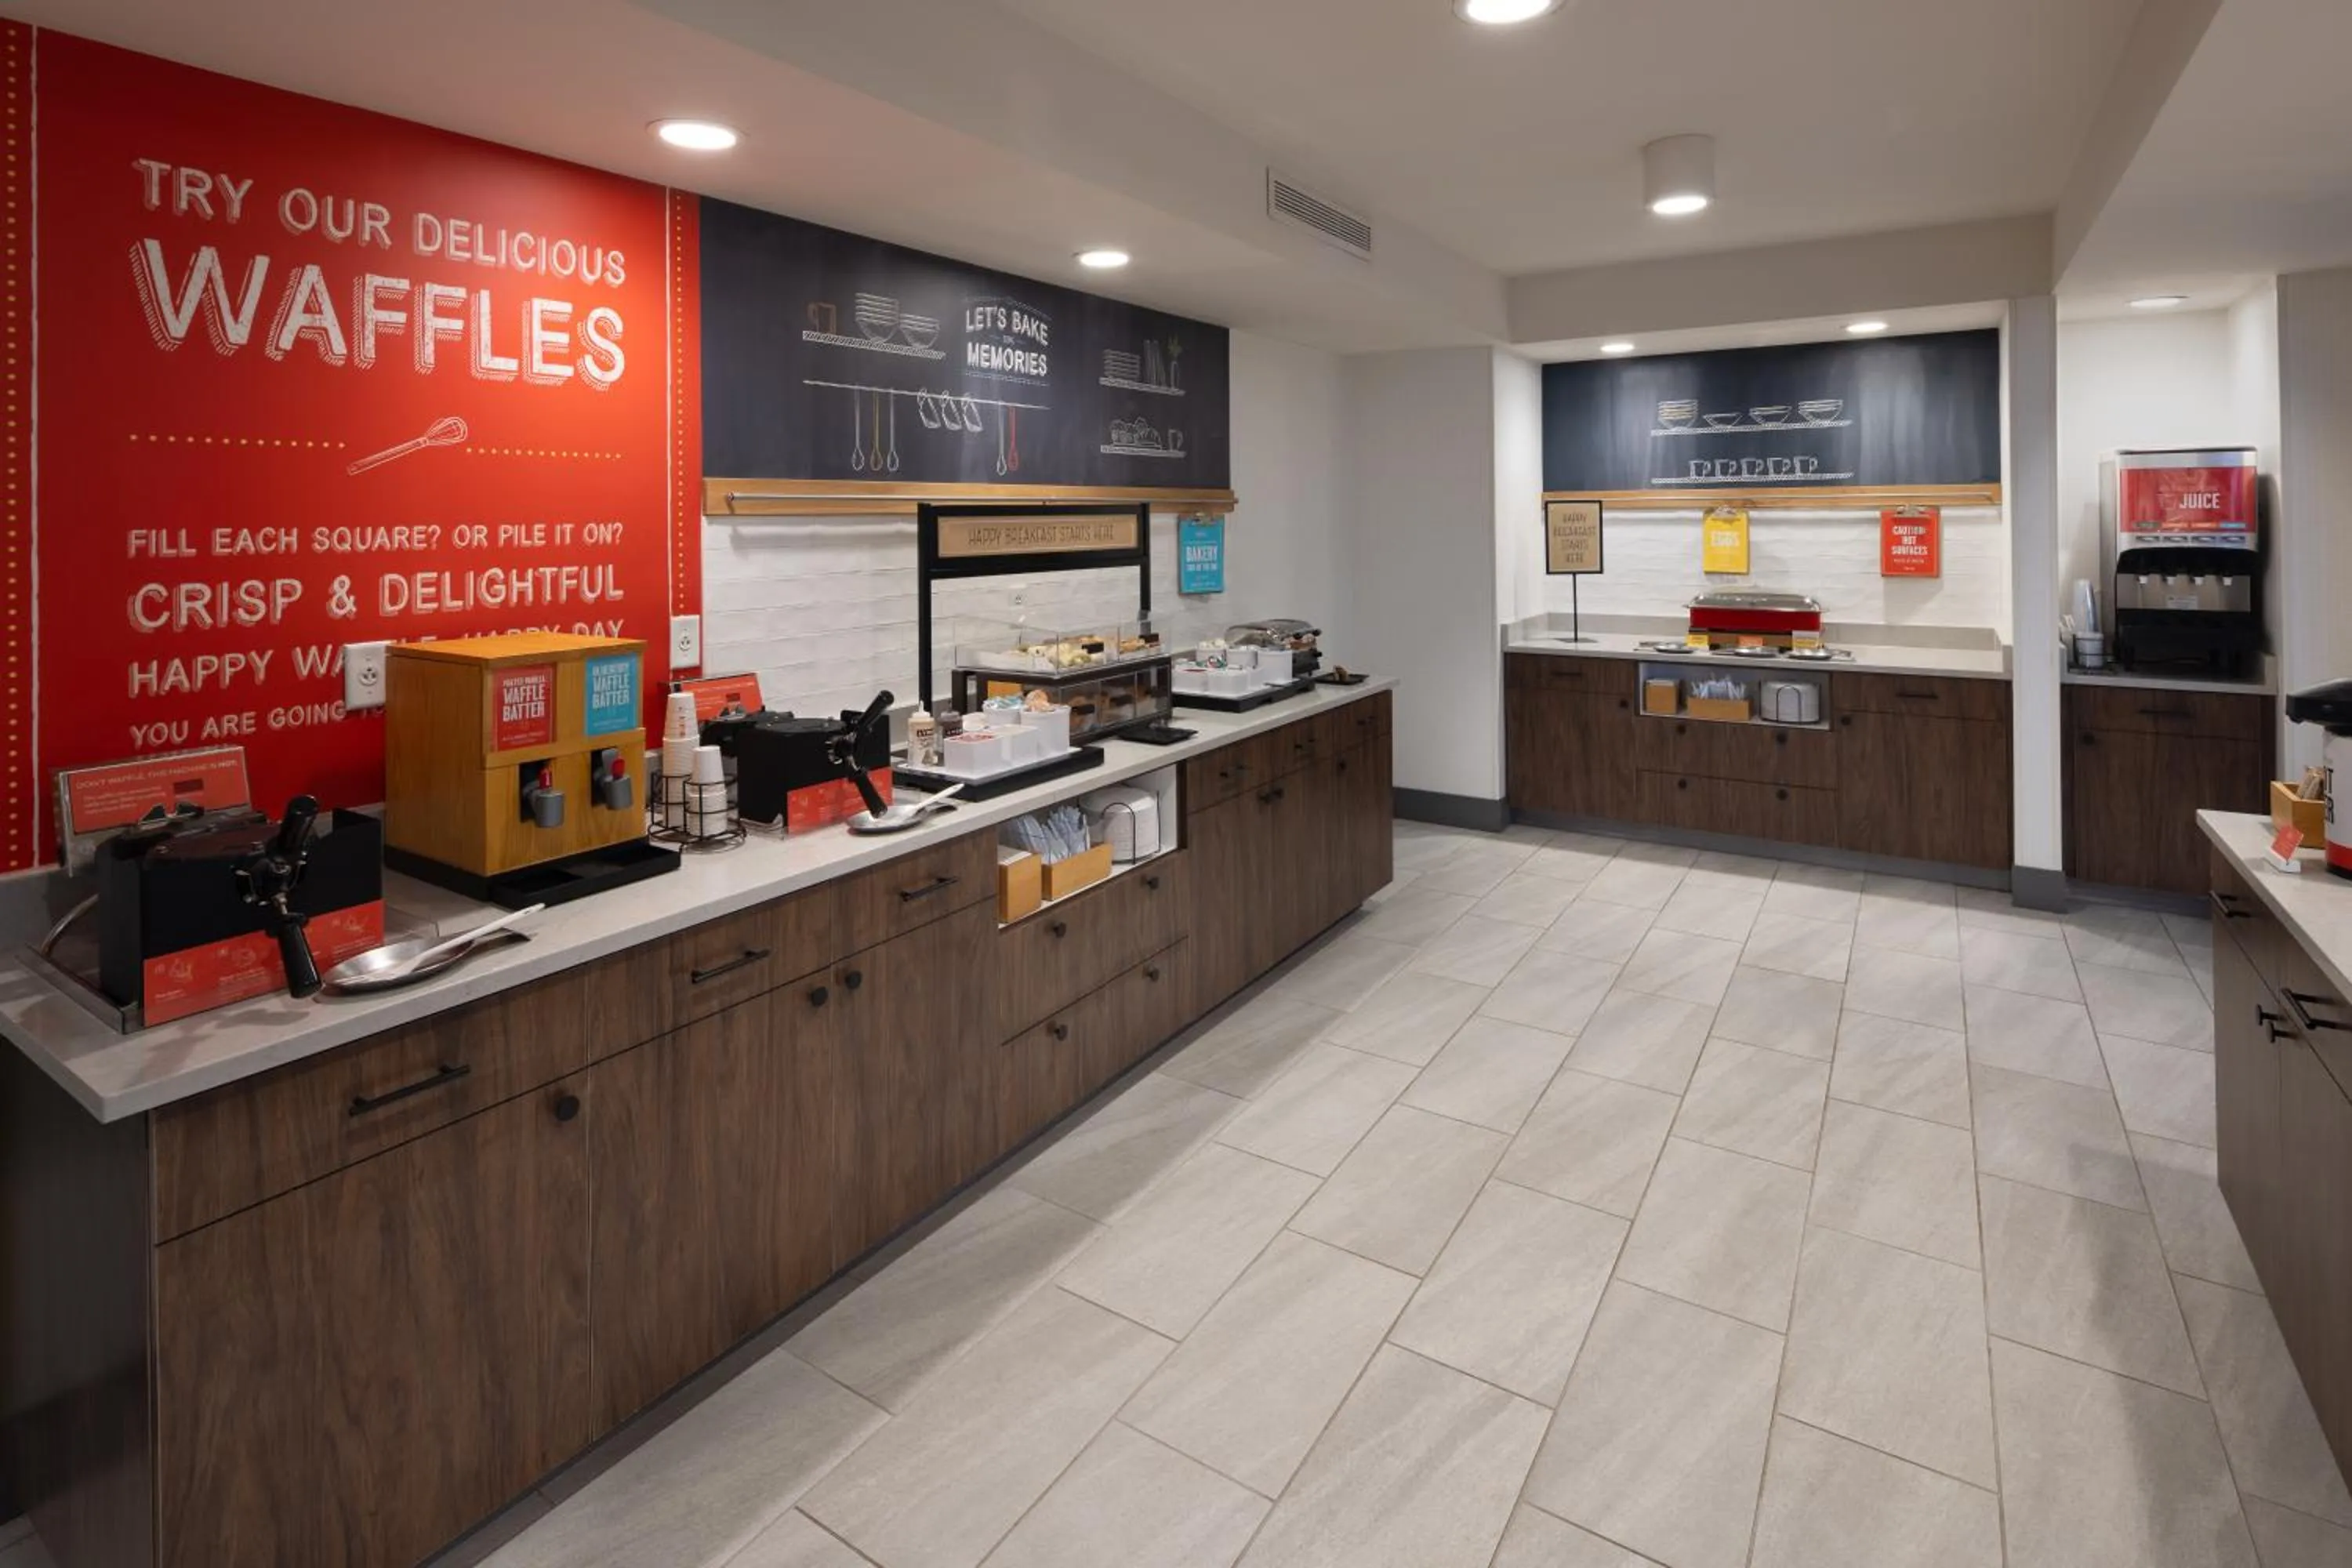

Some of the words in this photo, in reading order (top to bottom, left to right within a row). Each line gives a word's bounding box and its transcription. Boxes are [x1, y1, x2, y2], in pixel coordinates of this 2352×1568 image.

[132, 158, 253, 224] TRY
[278, 187, 391, 249] OUR
[413, 212, 626, 288] DELICIOUS
[129, 238, 625, 391] WAFFLES
[965, 305, 1007, 332] LET'S
[1011, 310, 1048, 347] BAKE
[967, 342, 1047, 376] MEMORIES
[2180, 493, 2220, 509] JUICE
[128, 528, 197, 558] FILL
[212, 527, 298, 555] EACH
[312, 524, 441, 554] SQUARE?
[452, 524, 488, 548] OR
[498, 524, 546, 548] PILE
[554, 524, 575, 546] IT
[583, 522, 624, 546] ON?
[127, 579, 303, 633] CRISP
[326, 575, 357, 619] &
[379, 564, 624, 616] DELIGHTFUL
[129, 649, 274, 698] HAPPY
[593, 673, 630, 691] WAFFLE
[503, 683, 546, 704] WAFFLE
[503, 701, 545, 721] BATTER
[592, 690, 630, 709] BATTER
[129, 720, 190, 750] YOU
[201, 711, 257, 740] ARE
[267, 699, 347, 730] GOING
